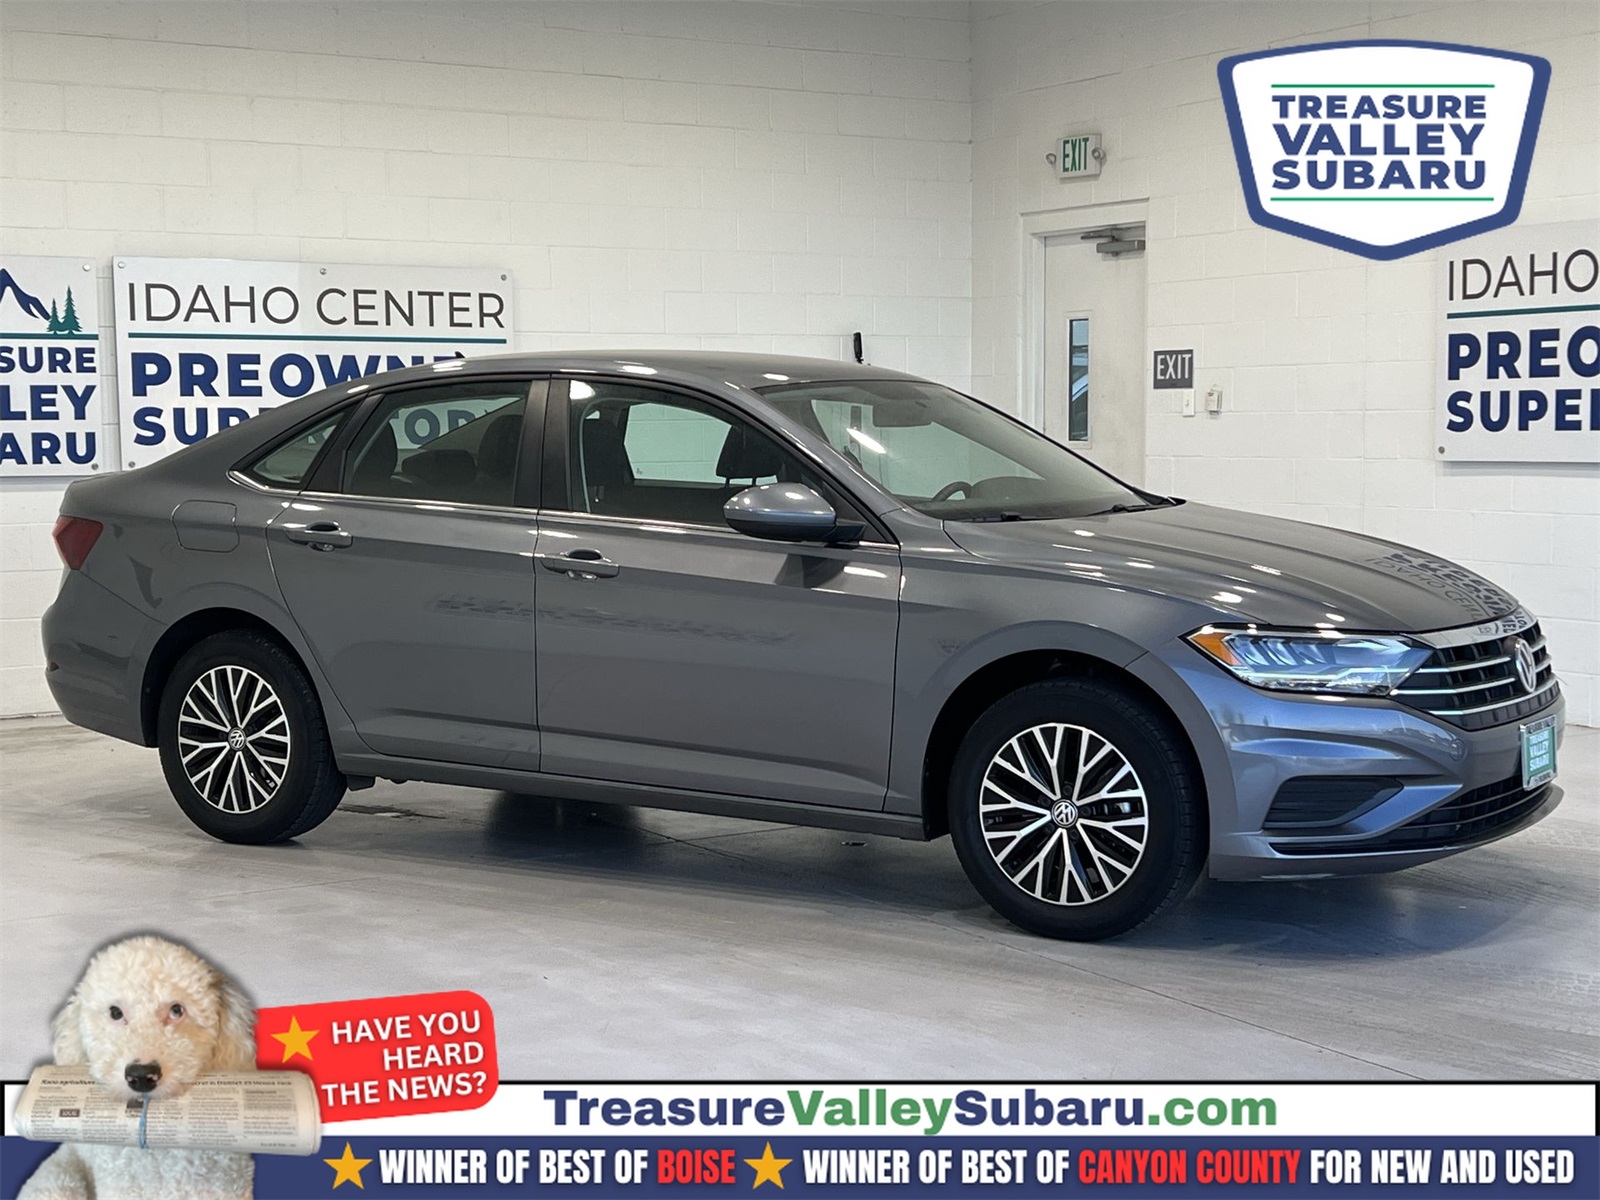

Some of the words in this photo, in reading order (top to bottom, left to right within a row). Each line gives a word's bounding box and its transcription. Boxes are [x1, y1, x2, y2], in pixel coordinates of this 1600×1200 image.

[1062, 137, 1090, 172] EXIT
[1448, 248, 1600, 302] IDAHO
[128, 282, 299, 324] IDAHO
[316, 288, 505, 329] CENTER
[1156, 353, 1192, 380] EXIT
